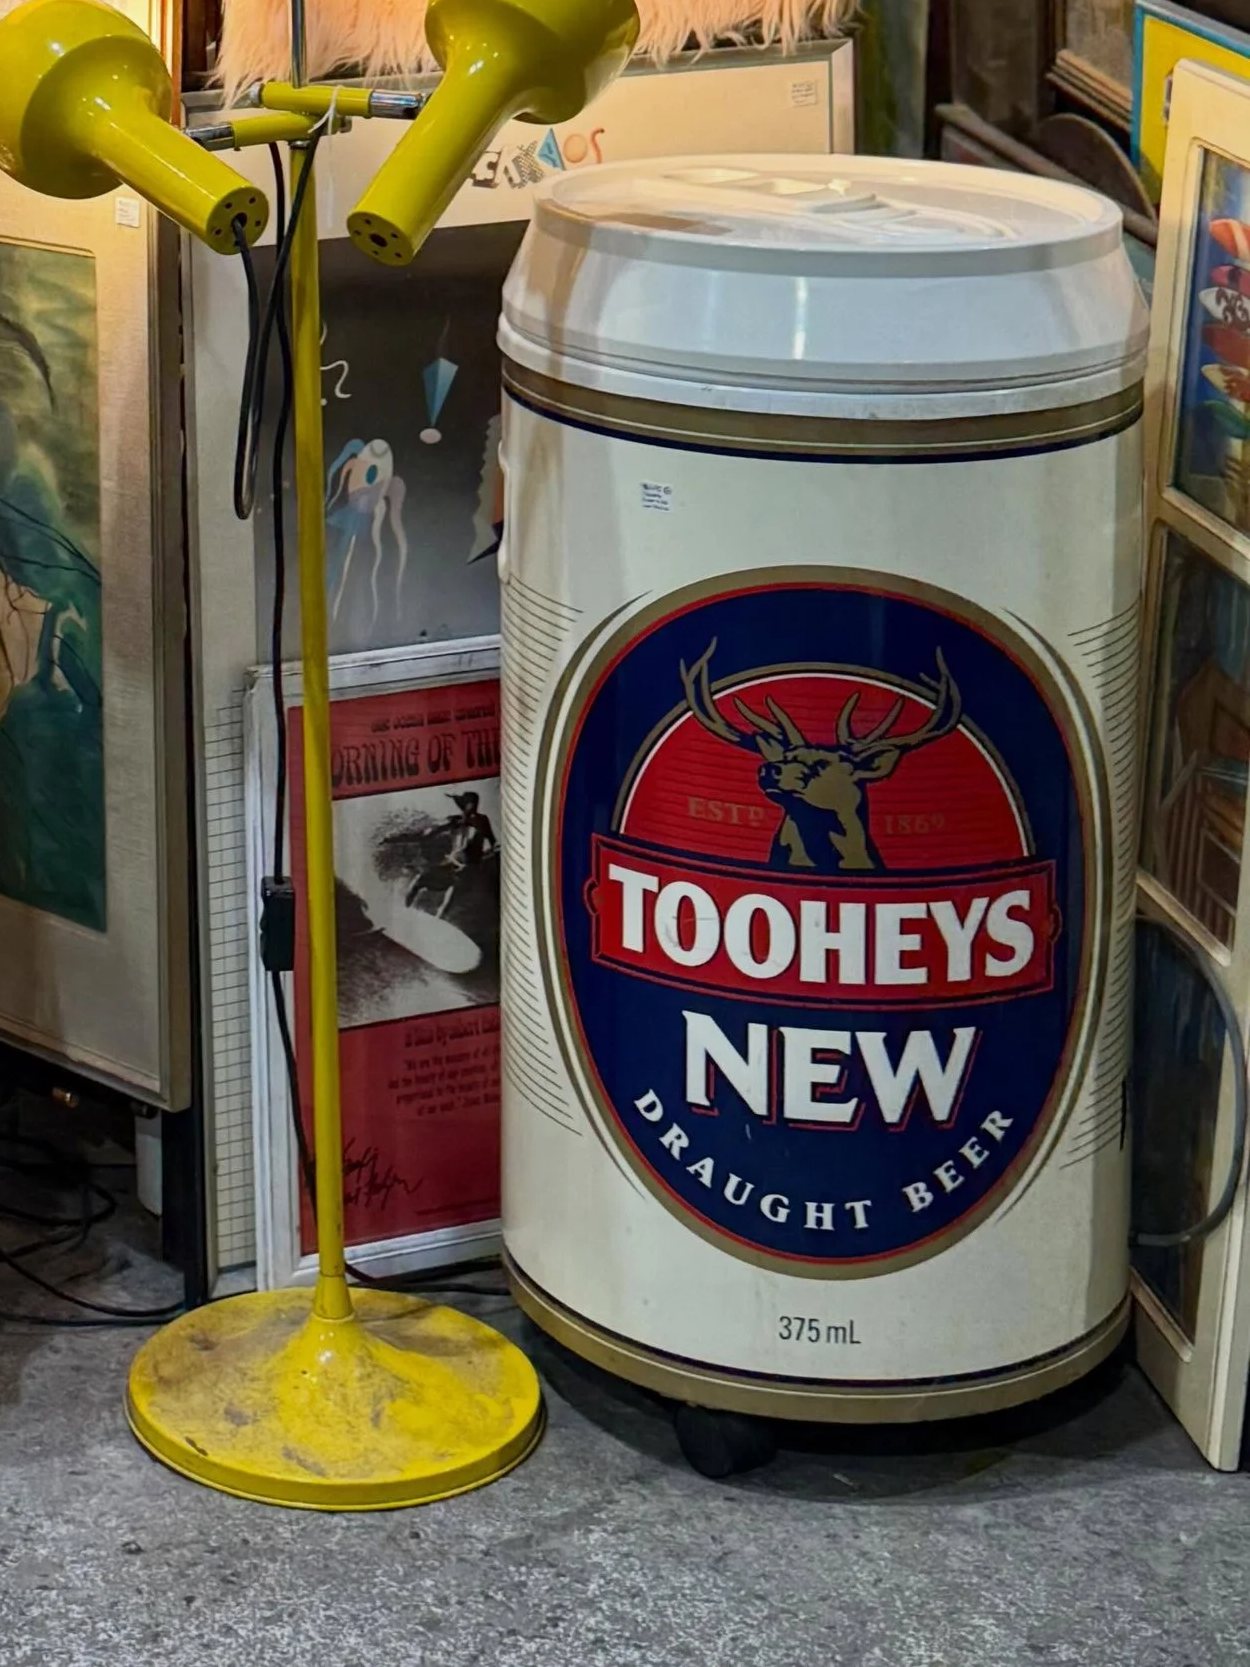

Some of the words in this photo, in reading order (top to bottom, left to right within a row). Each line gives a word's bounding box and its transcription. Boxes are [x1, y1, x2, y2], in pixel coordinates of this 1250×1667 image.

[331, 737, 420, 787] ORNING
[428, 734, 455, 774] OF
[608, 864, 1035, 985] TOOHEYS
[682, 1010, 979, 1127] NEW
[634, 1089, 872, 1231] DRAUGHT
[902, 1110, 1013, 1213] BEER
[778, 1315, 821, 1343] 375
[826, 1319, 862, 1344] mL
